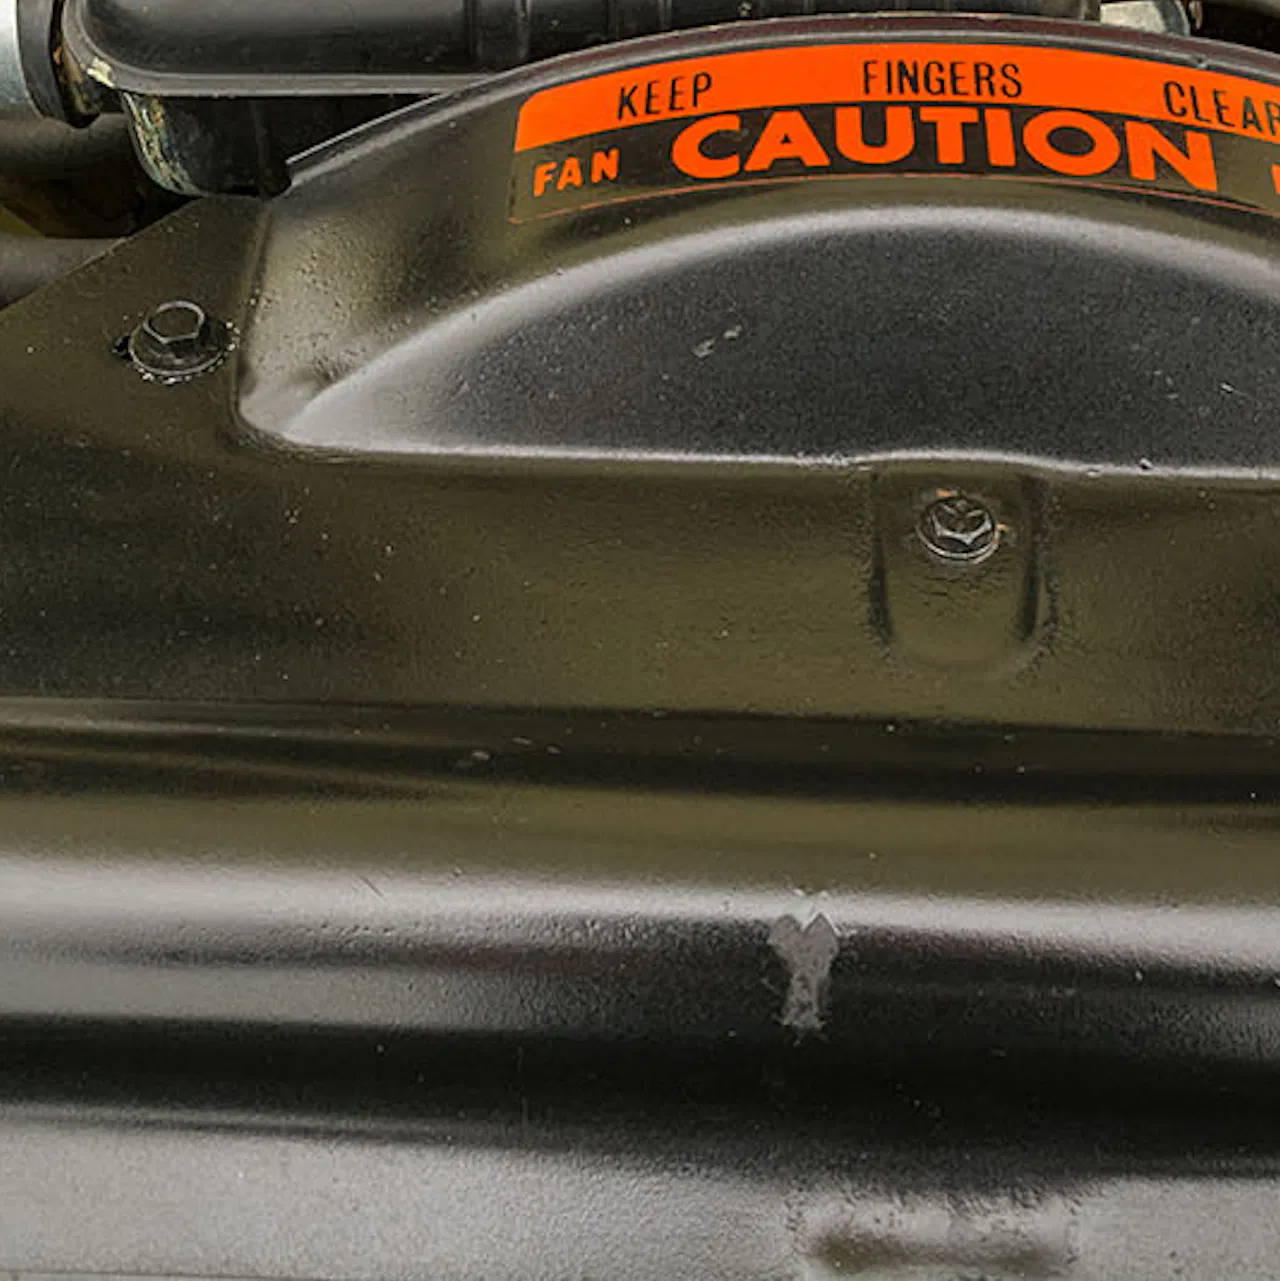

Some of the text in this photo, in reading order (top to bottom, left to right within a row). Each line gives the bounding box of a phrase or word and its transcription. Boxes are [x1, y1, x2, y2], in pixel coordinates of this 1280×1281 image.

[618, 71, 713, 121] KEEP
[863, 60, 1021, 97] FINGERS
[532, 147, 620, 197] FAN
[671, 106, 1218, 193] CAUTION
